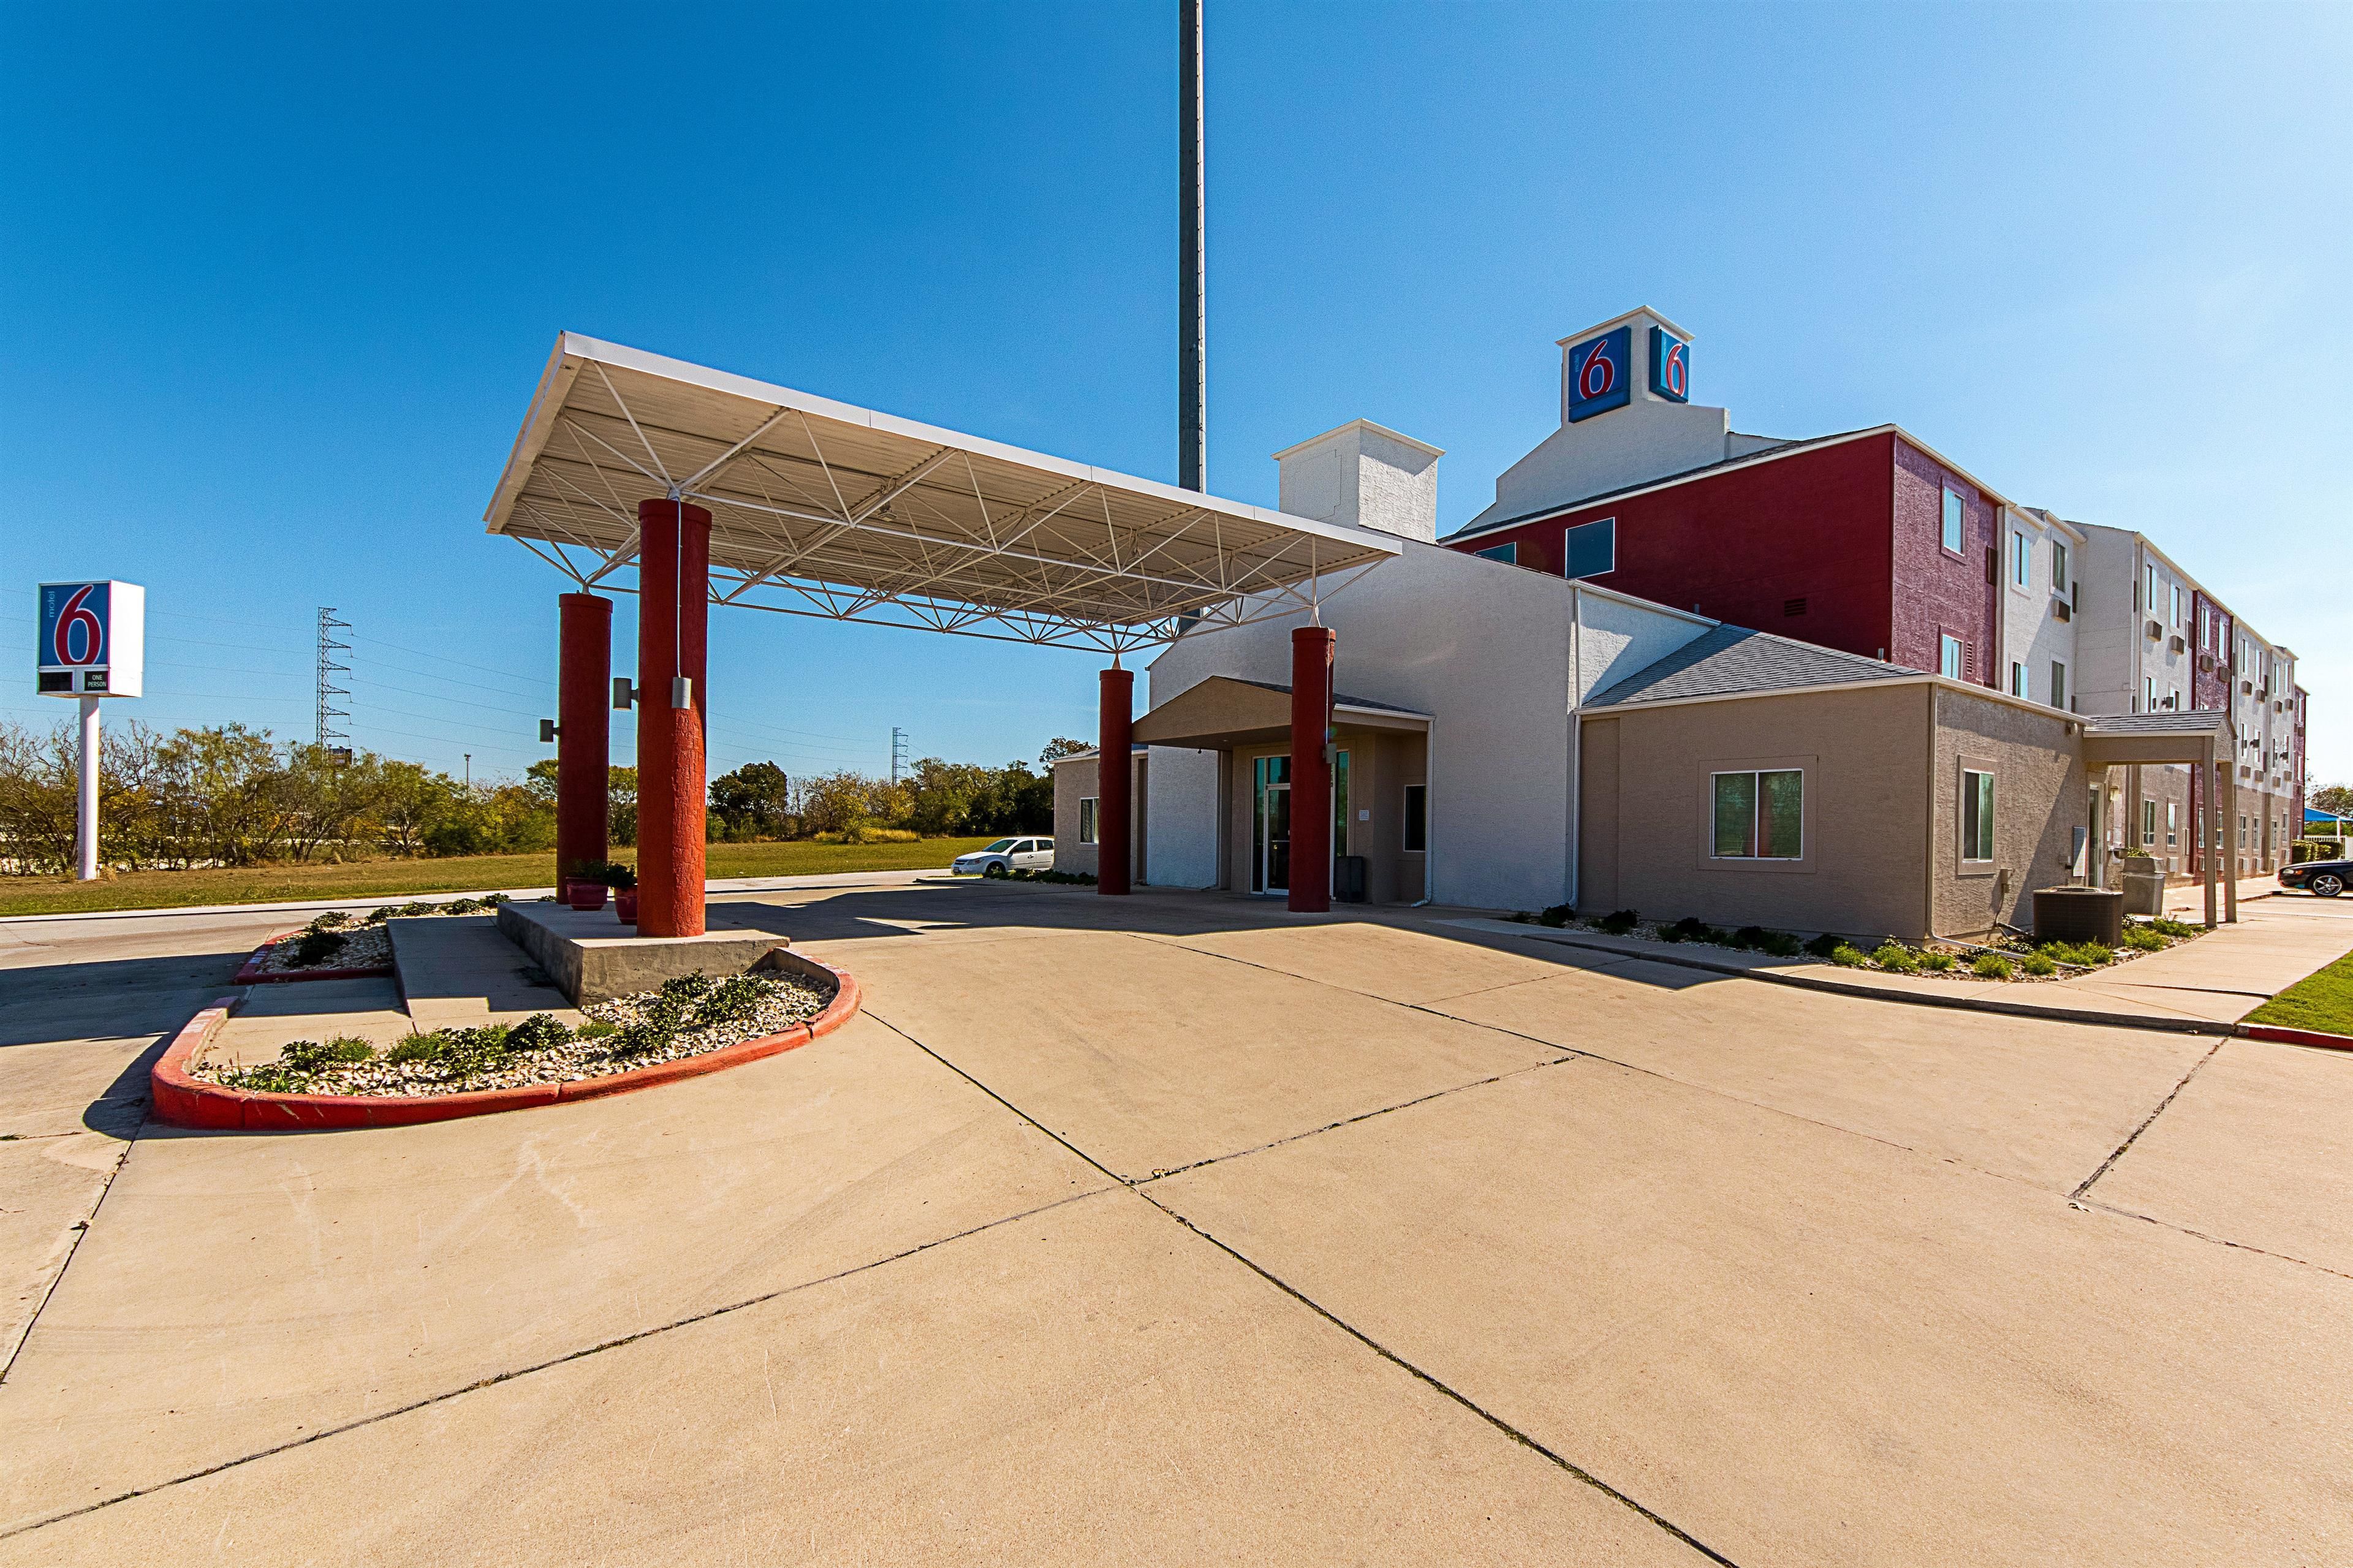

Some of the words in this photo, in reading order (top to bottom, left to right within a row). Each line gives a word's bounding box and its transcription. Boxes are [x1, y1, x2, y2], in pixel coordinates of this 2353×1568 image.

[1579, 339, 1615, 400] 6
[1666, 343, 1686, 397] 6
[54, 584, 103, 665] 6
